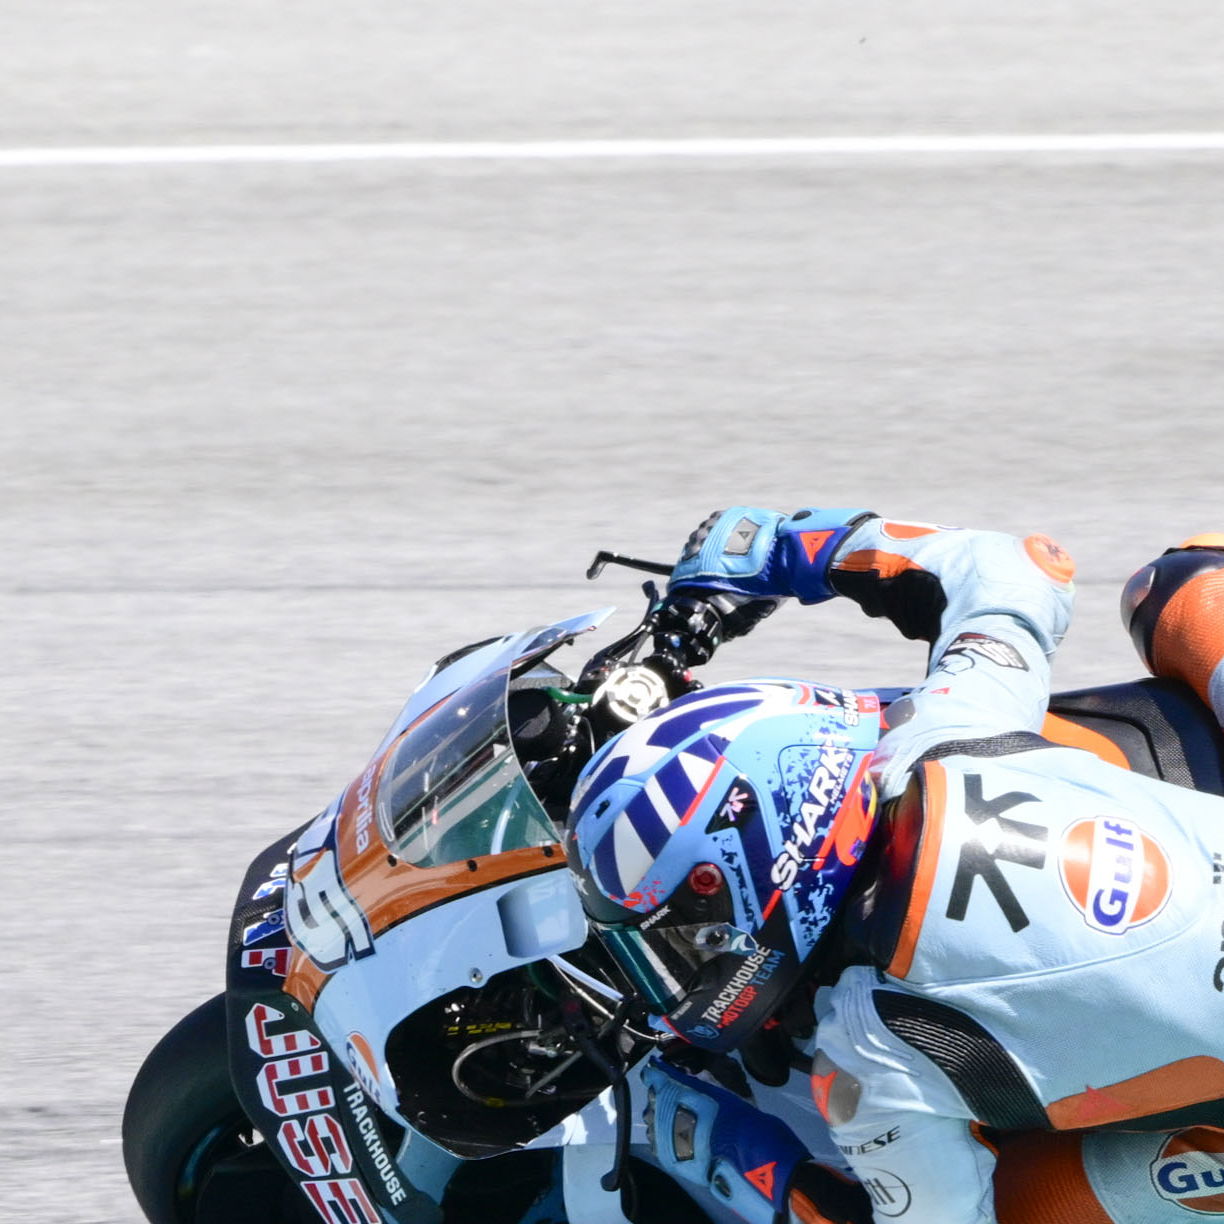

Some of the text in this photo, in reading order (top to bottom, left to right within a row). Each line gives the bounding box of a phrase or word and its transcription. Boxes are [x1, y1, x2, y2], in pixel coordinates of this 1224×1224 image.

[356, 764, 376, 854] aprilia
[770, 743, 854, 890] SHARK
[1093, 821, 1134, 927] Gulf
[701, 946, 771, 1023] TRACKHOUSE
[749, 950, 786, 987] TEAM
[343, 1080, 407, 1206] TRACKHOUSE
